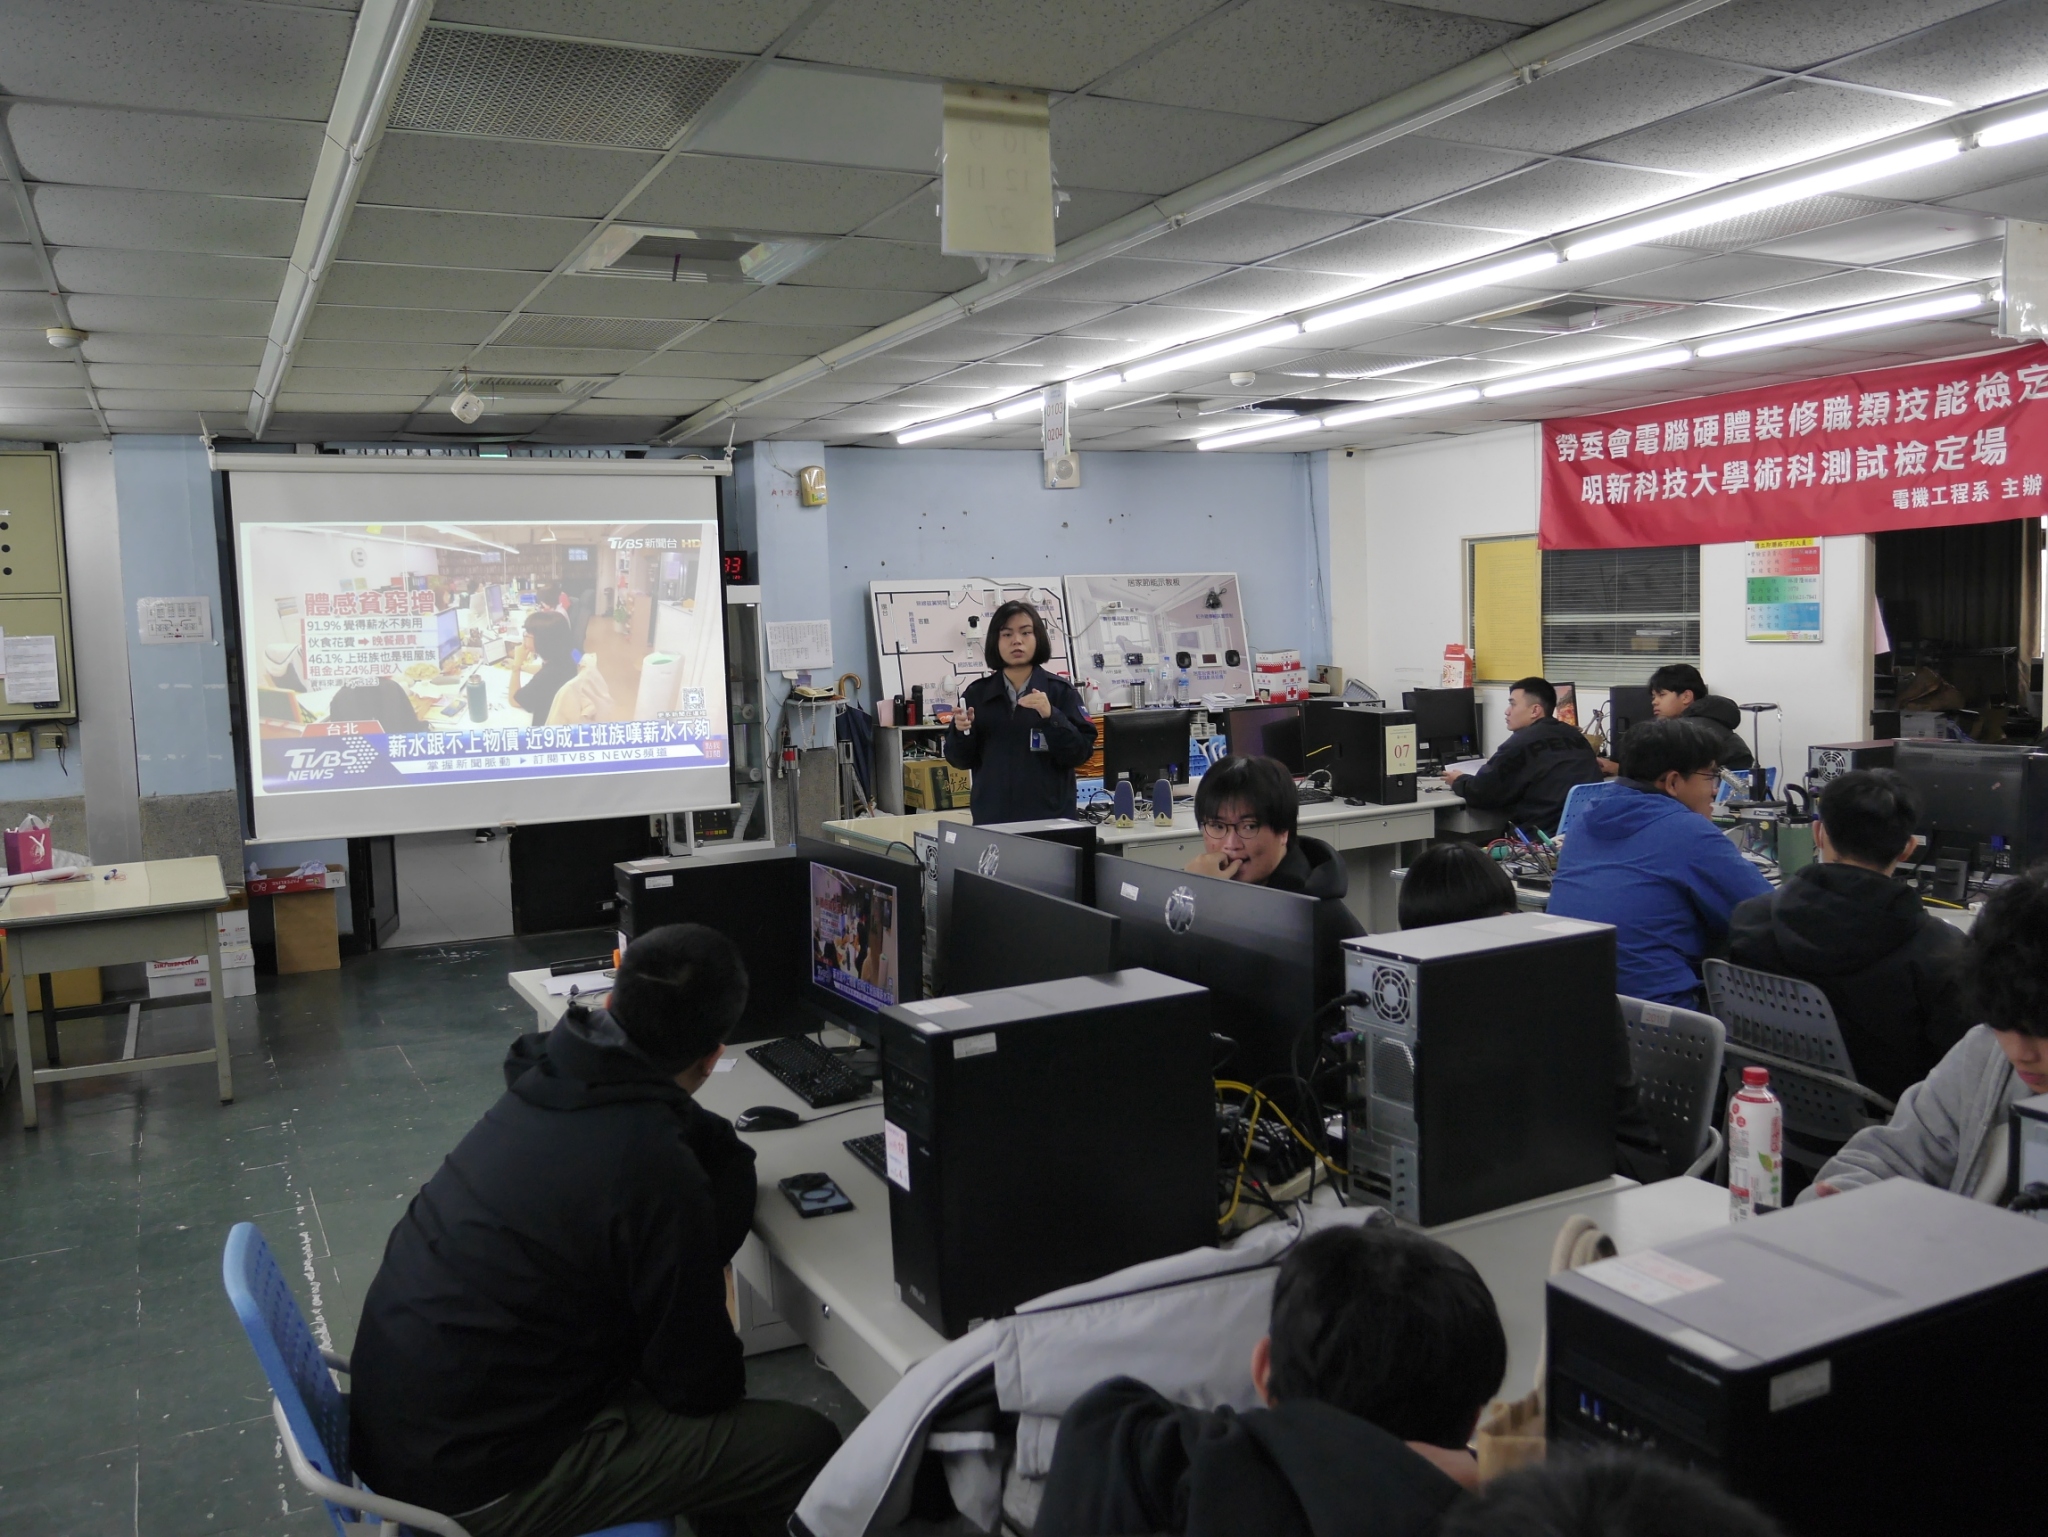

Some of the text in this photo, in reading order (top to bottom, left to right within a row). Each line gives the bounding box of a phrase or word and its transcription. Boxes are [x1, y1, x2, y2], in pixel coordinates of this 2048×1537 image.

[1555, 364, 2048, 463] 勞委會電腦硬體裝修職類技能檢定
[1581, 426, 2007, 505] 明新科技大學術科測試檢定場
[1892, 473, 2043, 510] 電機工程系 主辦
[607, 536, 703, 549] TVBS 新聞台 HD
[305, 590, 435, 616] 體感貧窮增
[306, 617, 423, 631] 91.9% 覺得薪水不夠用
[308, 634, 417, 648] 伙食花費 晚餐最貴
[308, 649, 437, 664] 46.1% 上班族也是租屋族
[309, 663, 402, 677] 租金占24%月收入
[326, 722, 359, 736] 台北
[388, 717, 710, 758] 薪水跟不上物價 近9成上班族嘆薪水不夠
[284, 748, 358, 768] TVBS
[1394, 744, 1410, 758] 07
[427, 756, 510, 771] 掌握新聞脈動
[287, 768, 334, 781] NEWS
